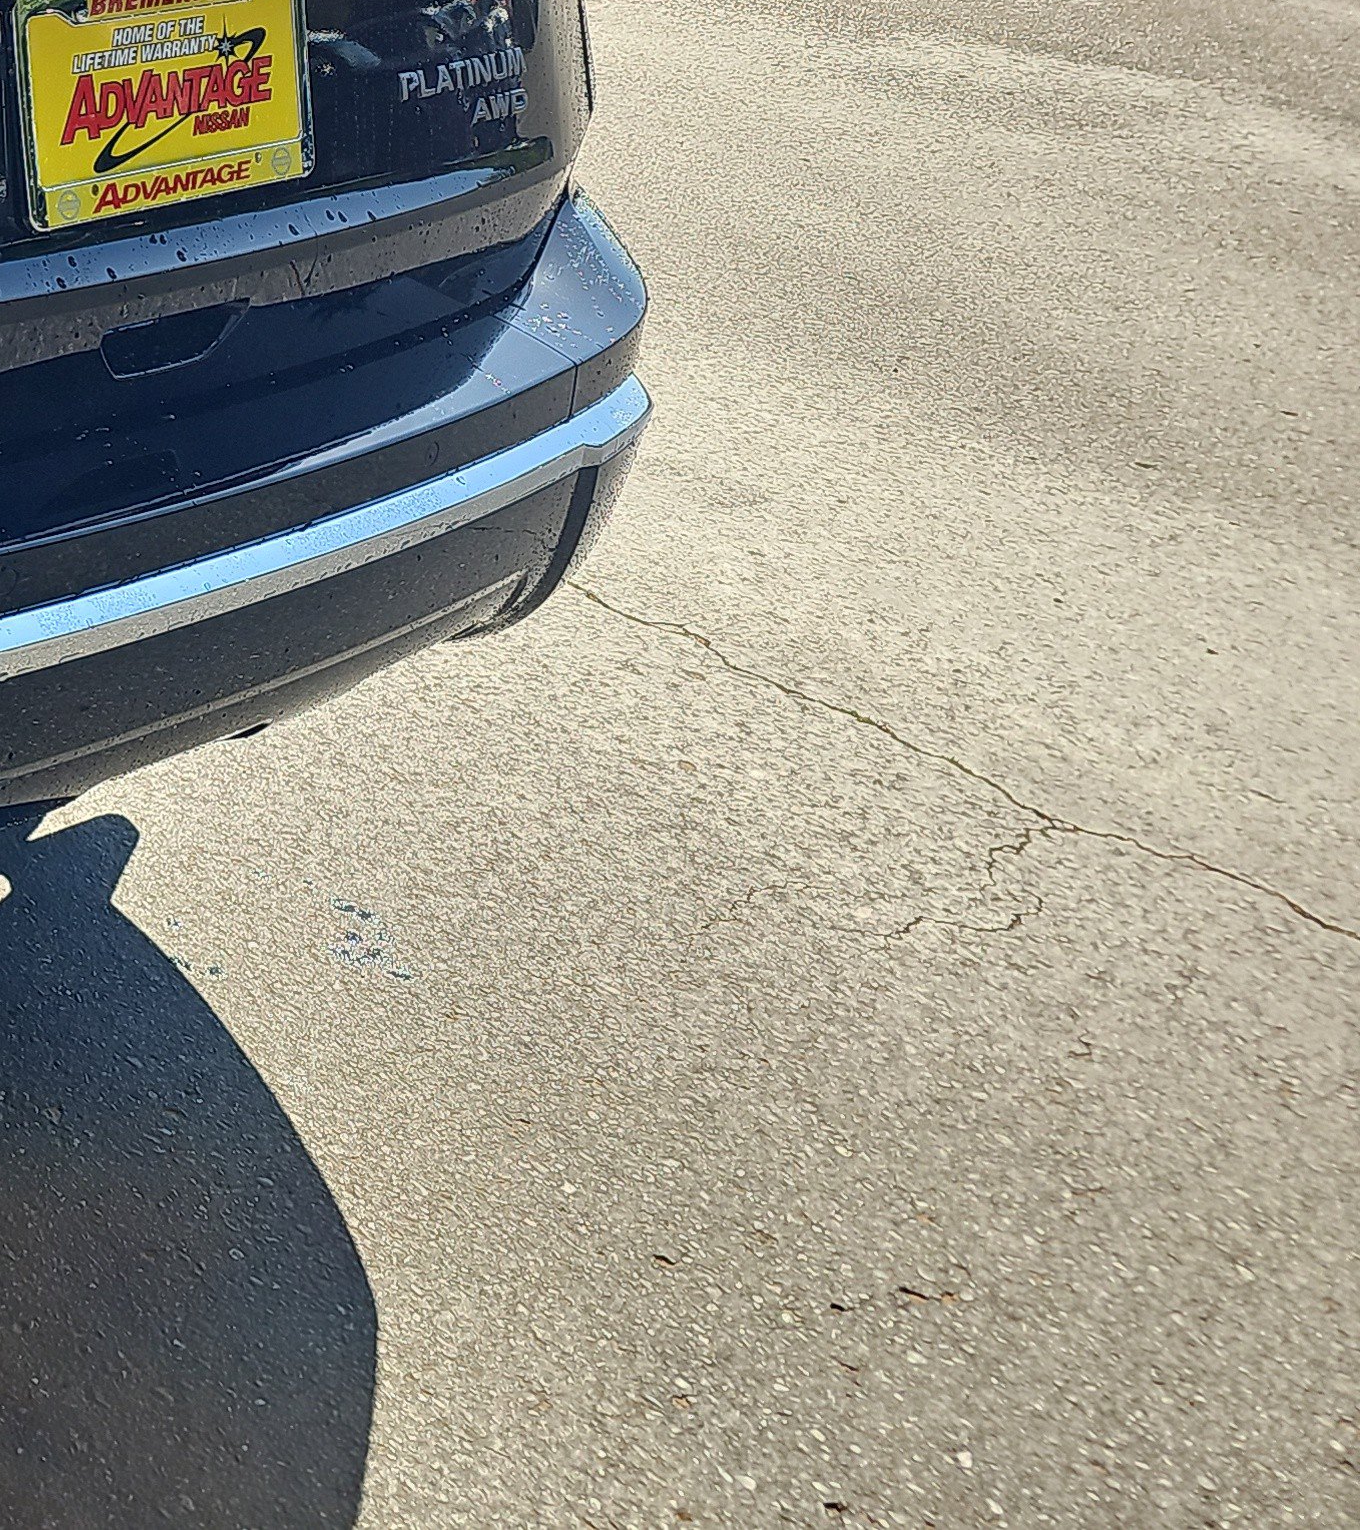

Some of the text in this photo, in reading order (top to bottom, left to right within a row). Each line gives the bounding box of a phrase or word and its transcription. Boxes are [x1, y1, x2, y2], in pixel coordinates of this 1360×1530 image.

[112, 15, 205, 47] HOME OF THE
[72, 33, 217, 74] LIFETIME WARRANTY
[398, 47, 528, 102] PLATINUM
[60, 56, 273, 145] ADVANTAGE
[470, 88, 529, 127] AWD
[192, 107, 250, 136] NISSAN
[93, 159, 252, 214] ADVANTAGE
